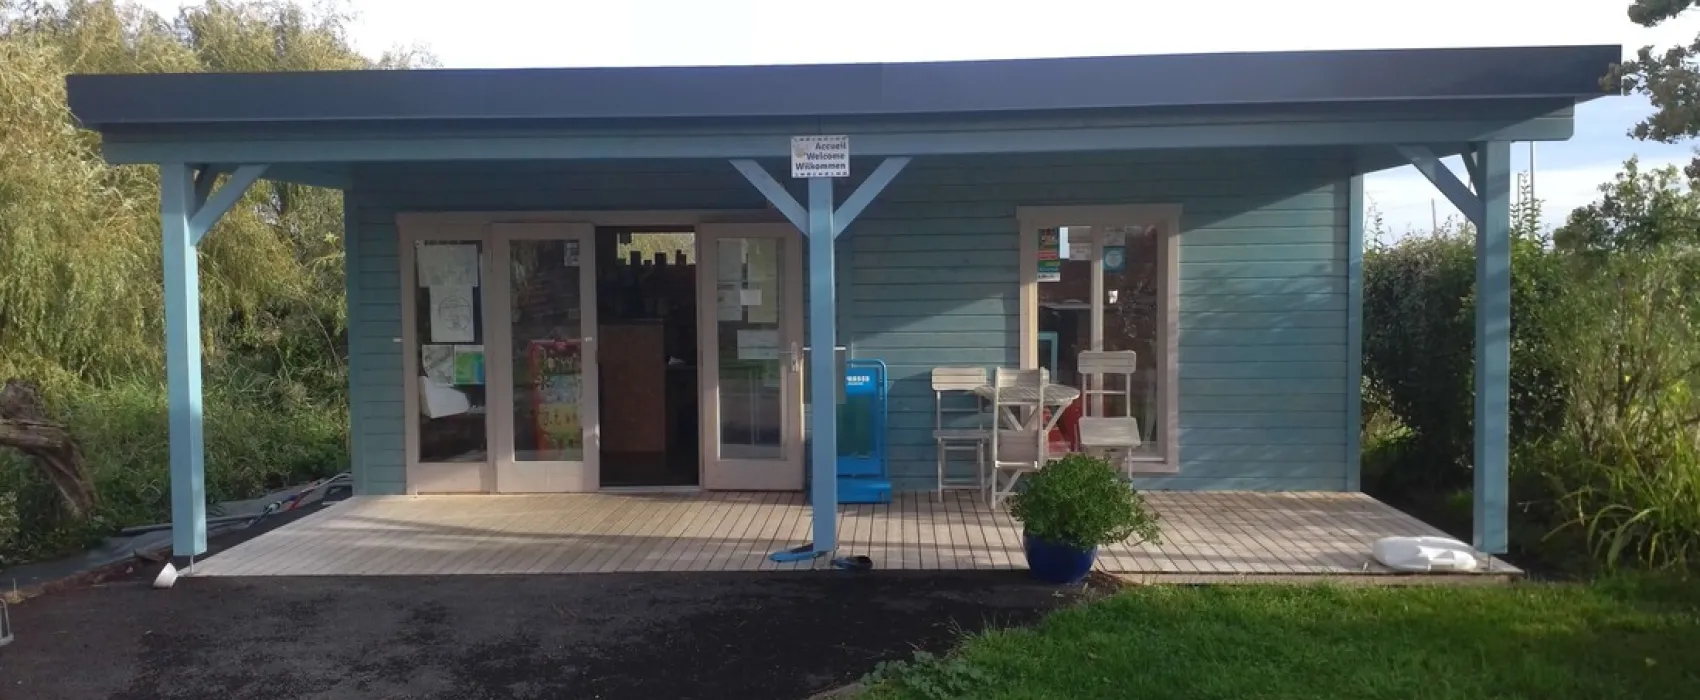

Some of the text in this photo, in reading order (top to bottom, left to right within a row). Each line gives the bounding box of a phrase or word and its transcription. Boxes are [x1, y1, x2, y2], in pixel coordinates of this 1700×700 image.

[815, 141, 847, 150] Accueil
[806, 151, 845, 160] Welcome
[795, 162, 846, 170] Willkommen
